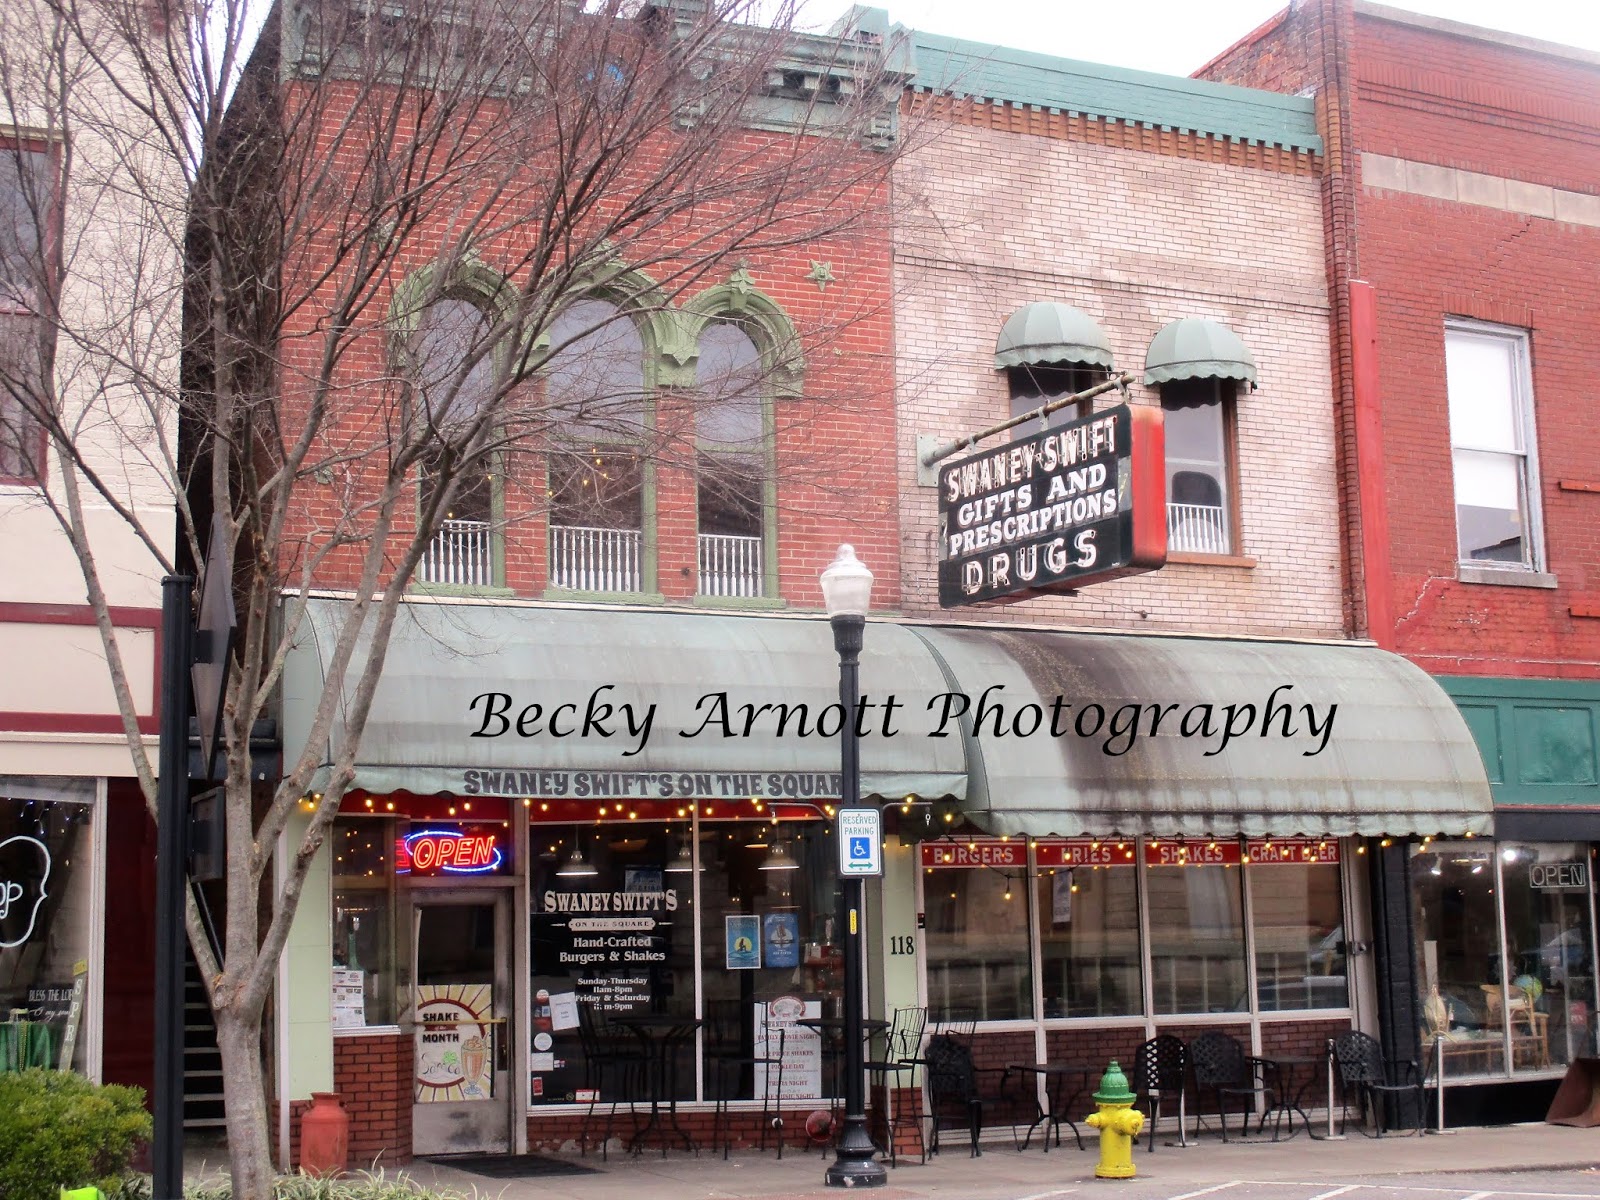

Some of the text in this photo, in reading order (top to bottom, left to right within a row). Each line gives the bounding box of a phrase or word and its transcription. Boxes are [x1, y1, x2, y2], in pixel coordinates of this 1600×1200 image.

[957, 463, 1108, 527] GIFTS AND
[949, 488, 1118, 556] PRESCRIPTIONS
[961, 529, 1098, 595] DRUGS
[463, 769, 843, 799] SWANEY SWIFT'S ON THE SQUAR
[843, 816, 877, 825] RESERVED
[844, 827, 875, 836] PARKING
[413, 837, 495, 869] OPEN
[933, 847, 1014, 864] BURGERS
[1160, 846, 1224, 863] SHAKES
[1250, 846, 1296, 862] CRAFT
[1531, 865, 1584, 886] OPEN
[544, 889, 678, 913] SWANEY SWIFT'S
[573, 936, 653, 948] Hand-Crafted
[890, 936, 915, 955] 118
[559, 950, 666, 965] Burgers & Shakes
[577, 977, 648, 986] Sunday-Thursday
[28, 989, 74, 1001] BLESS THE LOR
[575, 995, 601, 1003] Friday
[614, 994, 651, 1003] Saturday
[422, 1012, 460, 1022] SHAKE
[422, 1033, 460, 1043] MONTH
